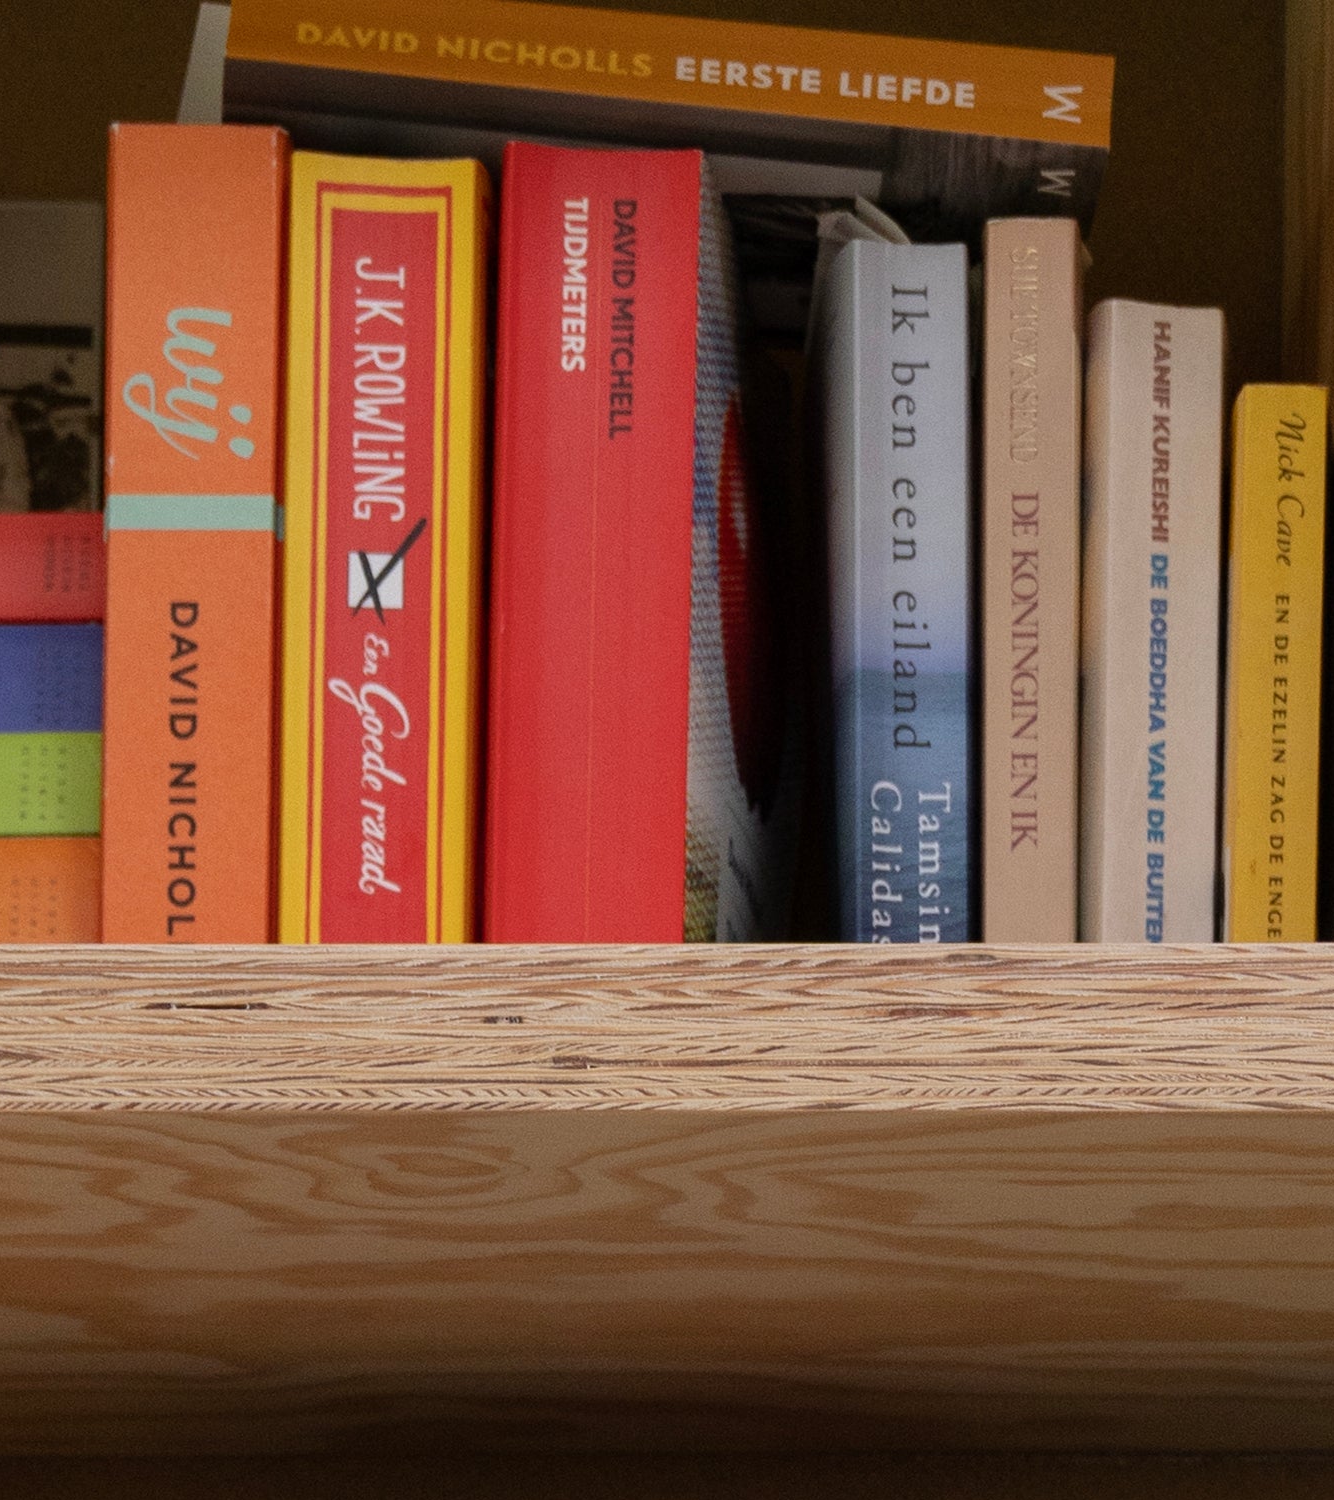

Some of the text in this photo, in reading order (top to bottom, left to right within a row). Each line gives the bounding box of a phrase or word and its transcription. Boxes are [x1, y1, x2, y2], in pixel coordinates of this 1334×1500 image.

[297, 21, 976, 110] DAVID NICHOLLS EERSTE LIEFDE
[354, 255, 407, 322] J.K.
[561, 197, 589, 373] TIJDMETERS
[608, 200, 637, 440] DAVID MITCHELL
[123, 305, 257, 460] wij
[891, 283, 931, 749] Ik ben een eiland
[1274, 412, 1307, 567] Nick Cave
[1010, 491, 1039, 851] DE KONINGIN EN IK
[328, 632, 409, 895] Een Goede raad
